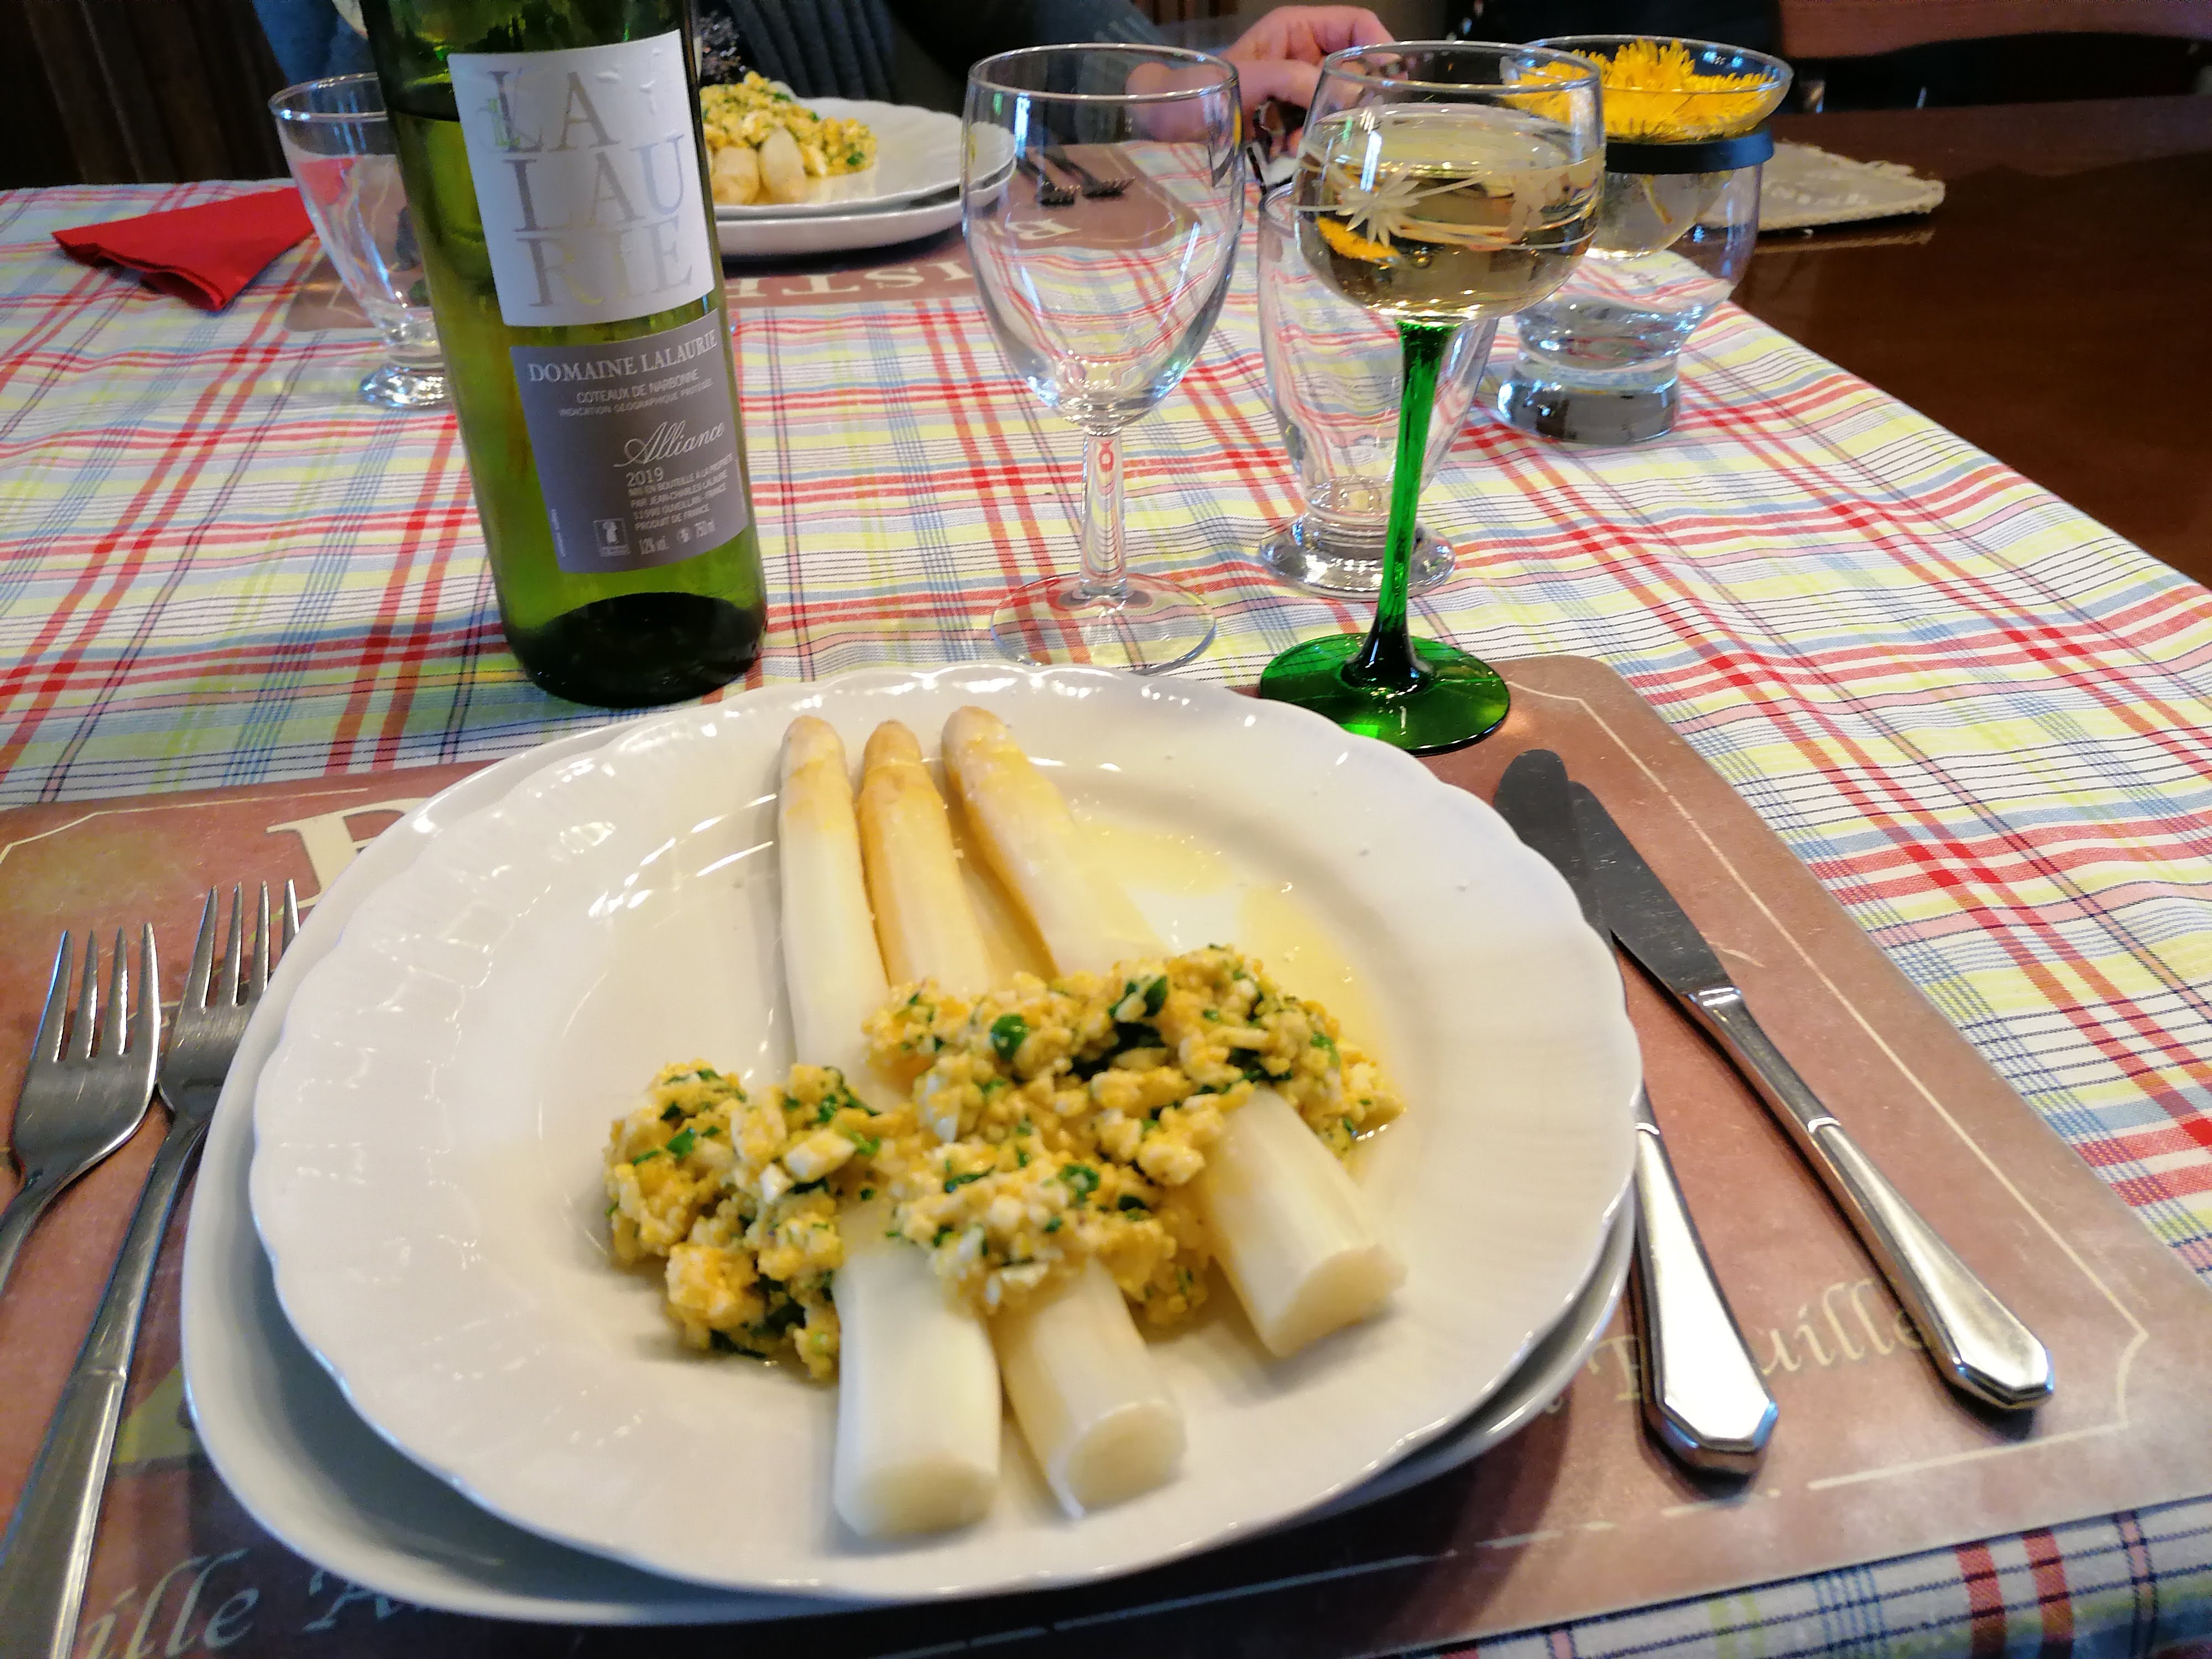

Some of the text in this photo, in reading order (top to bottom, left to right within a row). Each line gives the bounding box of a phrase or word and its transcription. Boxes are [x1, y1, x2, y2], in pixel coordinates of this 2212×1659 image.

[528, 329, 718, 383] DOMAINE LALAURIE
[632, 384, 648, 396] DE
[613, 419, 726, 468] Alliance
[625, 467, 664, 487] 2019
